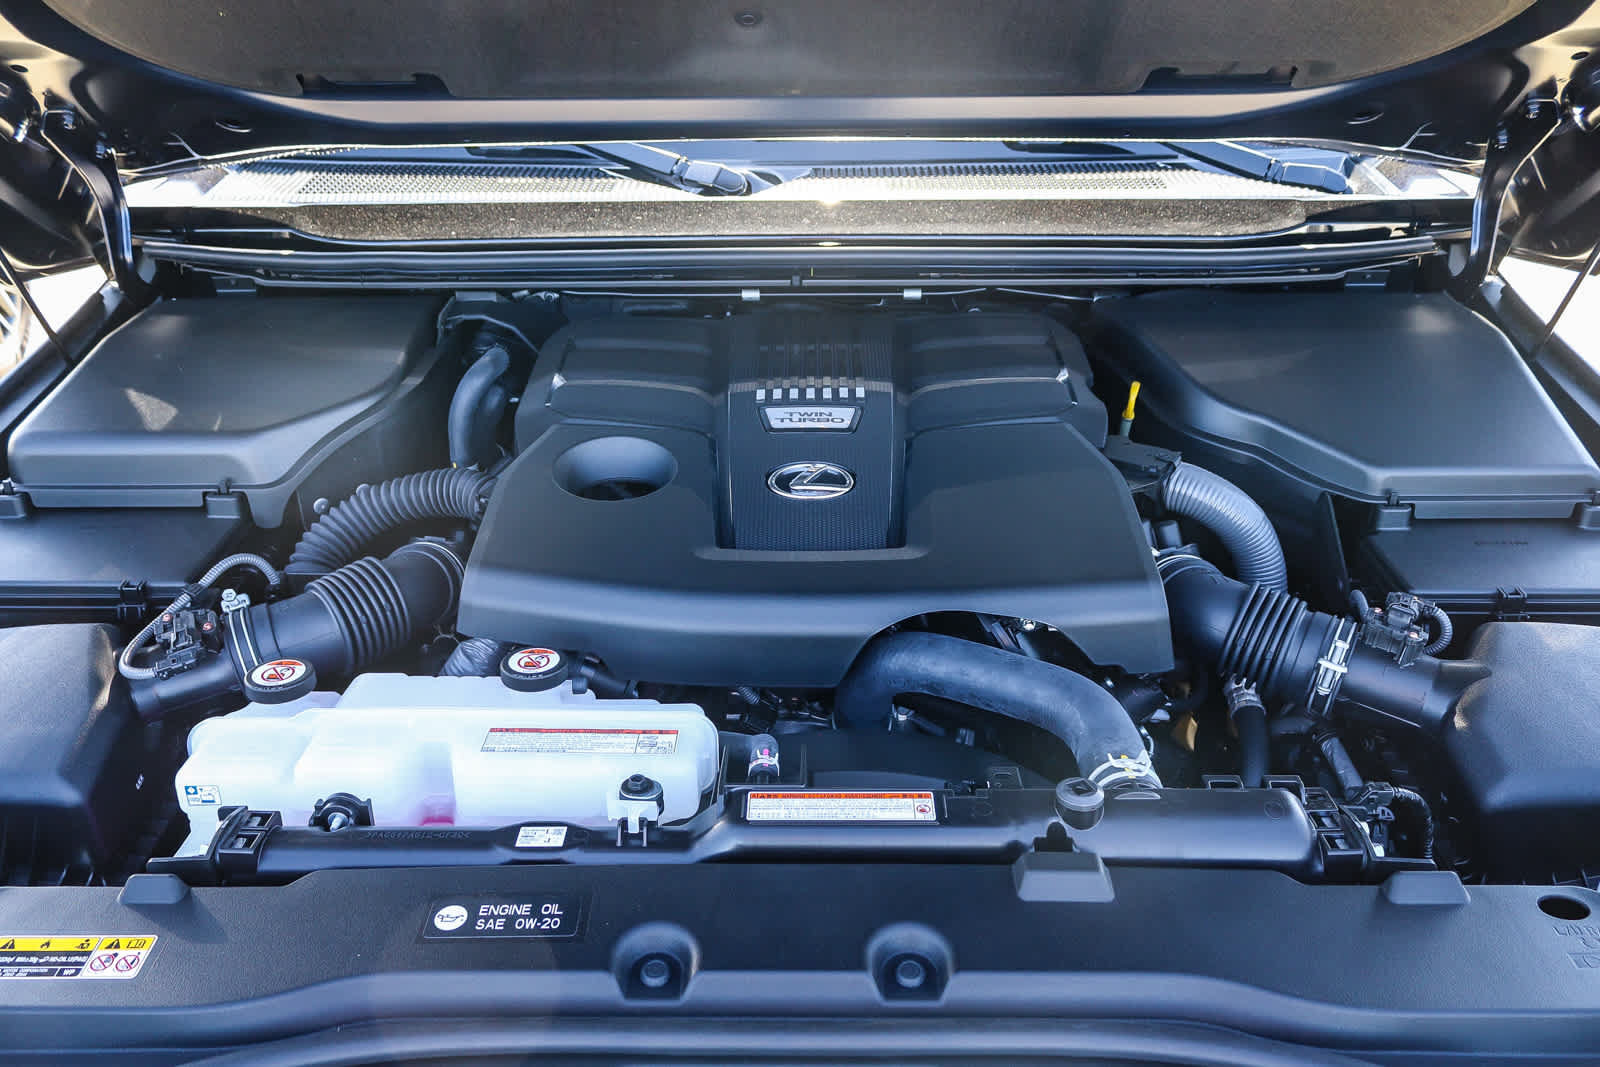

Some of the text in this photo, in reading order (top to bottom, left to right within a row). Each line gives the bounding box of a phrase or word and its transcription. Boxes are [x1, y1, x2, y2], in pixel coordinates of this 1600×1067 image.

[478, 903, 564, 916] ENGINE OIL
[475, 917, 561, 930] SAE 0W-20
